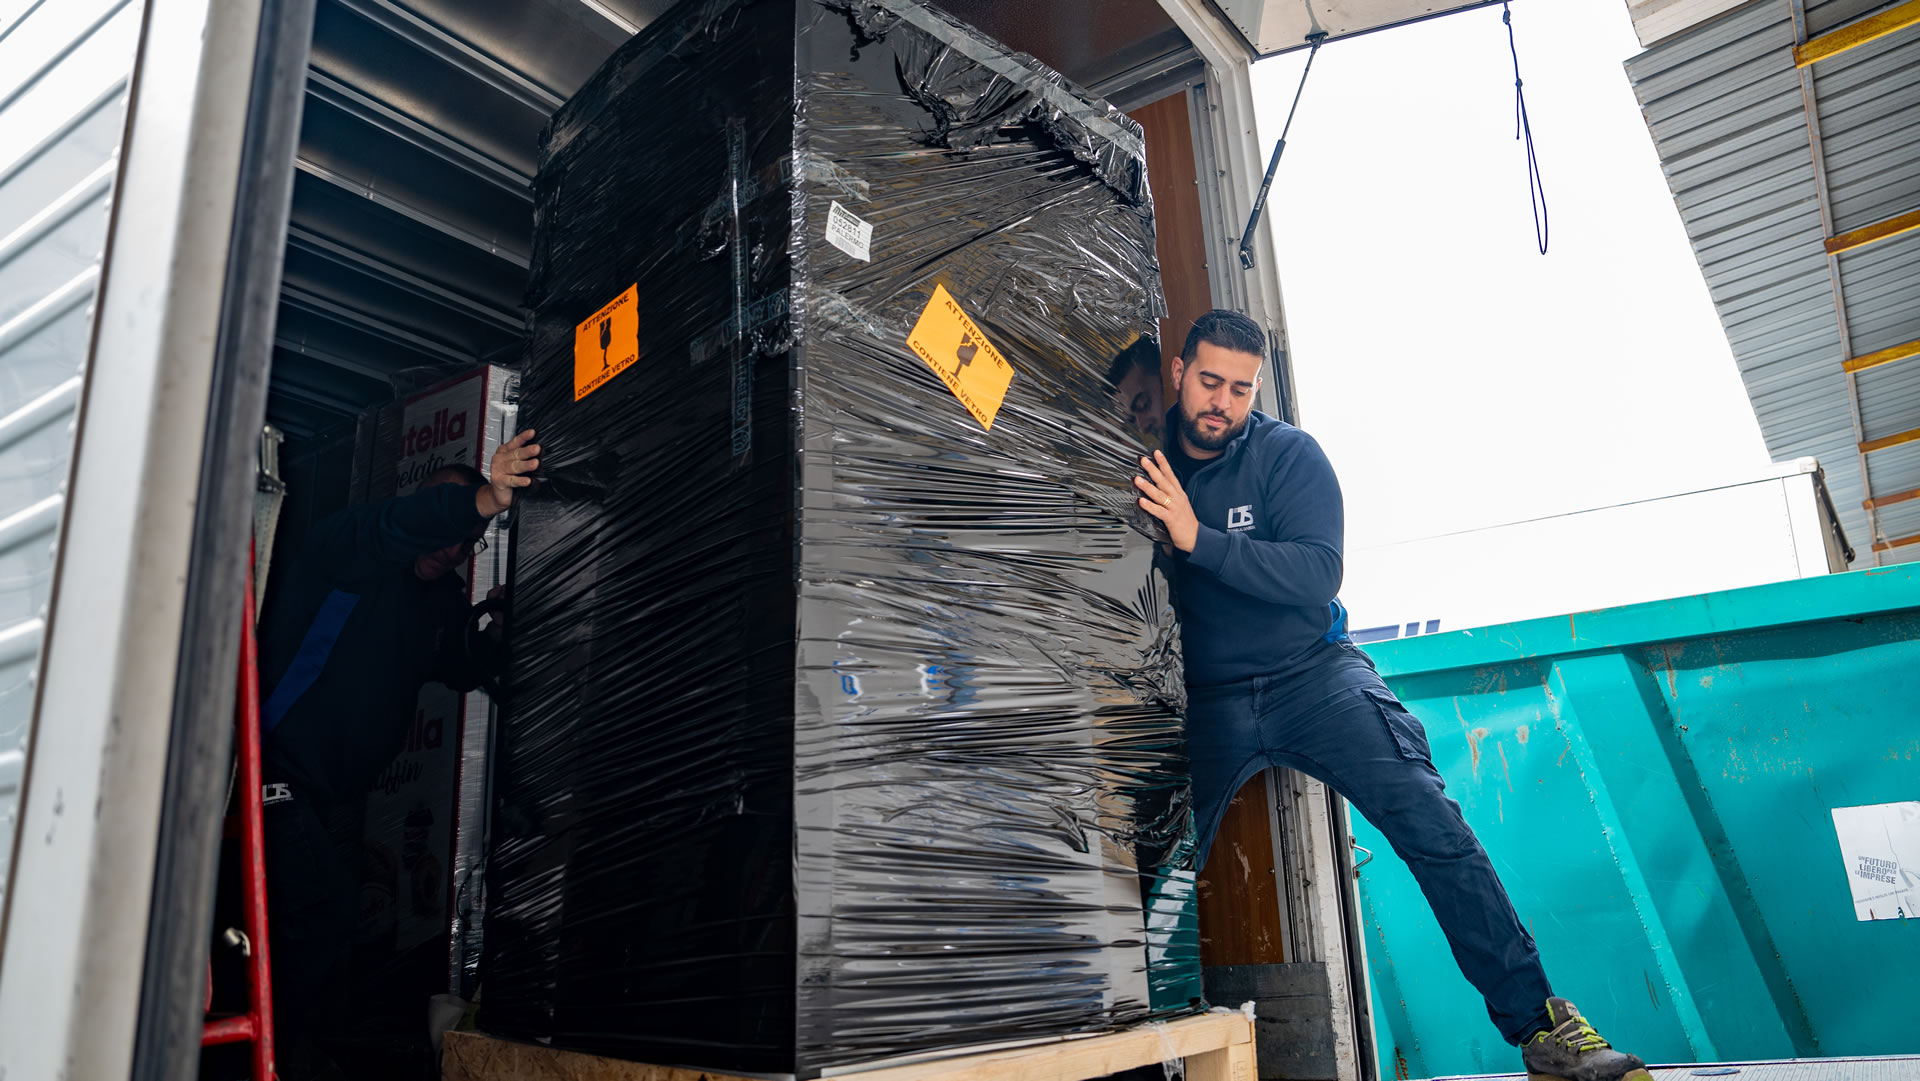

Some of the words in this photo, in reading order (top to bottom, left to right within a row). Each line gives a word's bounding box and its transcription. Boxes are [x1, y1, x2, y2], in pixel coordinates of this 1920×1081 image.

[831, 225, 864, 249] PALERMO
[833, 216, 861, 239] 052811
[582, 293, 629, 333] ATTENZIONE
[945, 300, 1005, 370] ATTENZIONE
[577, 369, 611, 397] CONTIENE
[611, 353, 635, 374] VETRO
[912, 340, 960, 391] CONTIENE
[960, 388, 988, 423] VETRO
[1859, 863, 1887, 875] LIBERO
[1865, 856, 1897, 870] FUTURO
[1860, 871, 1896, 885] IMPRESE
